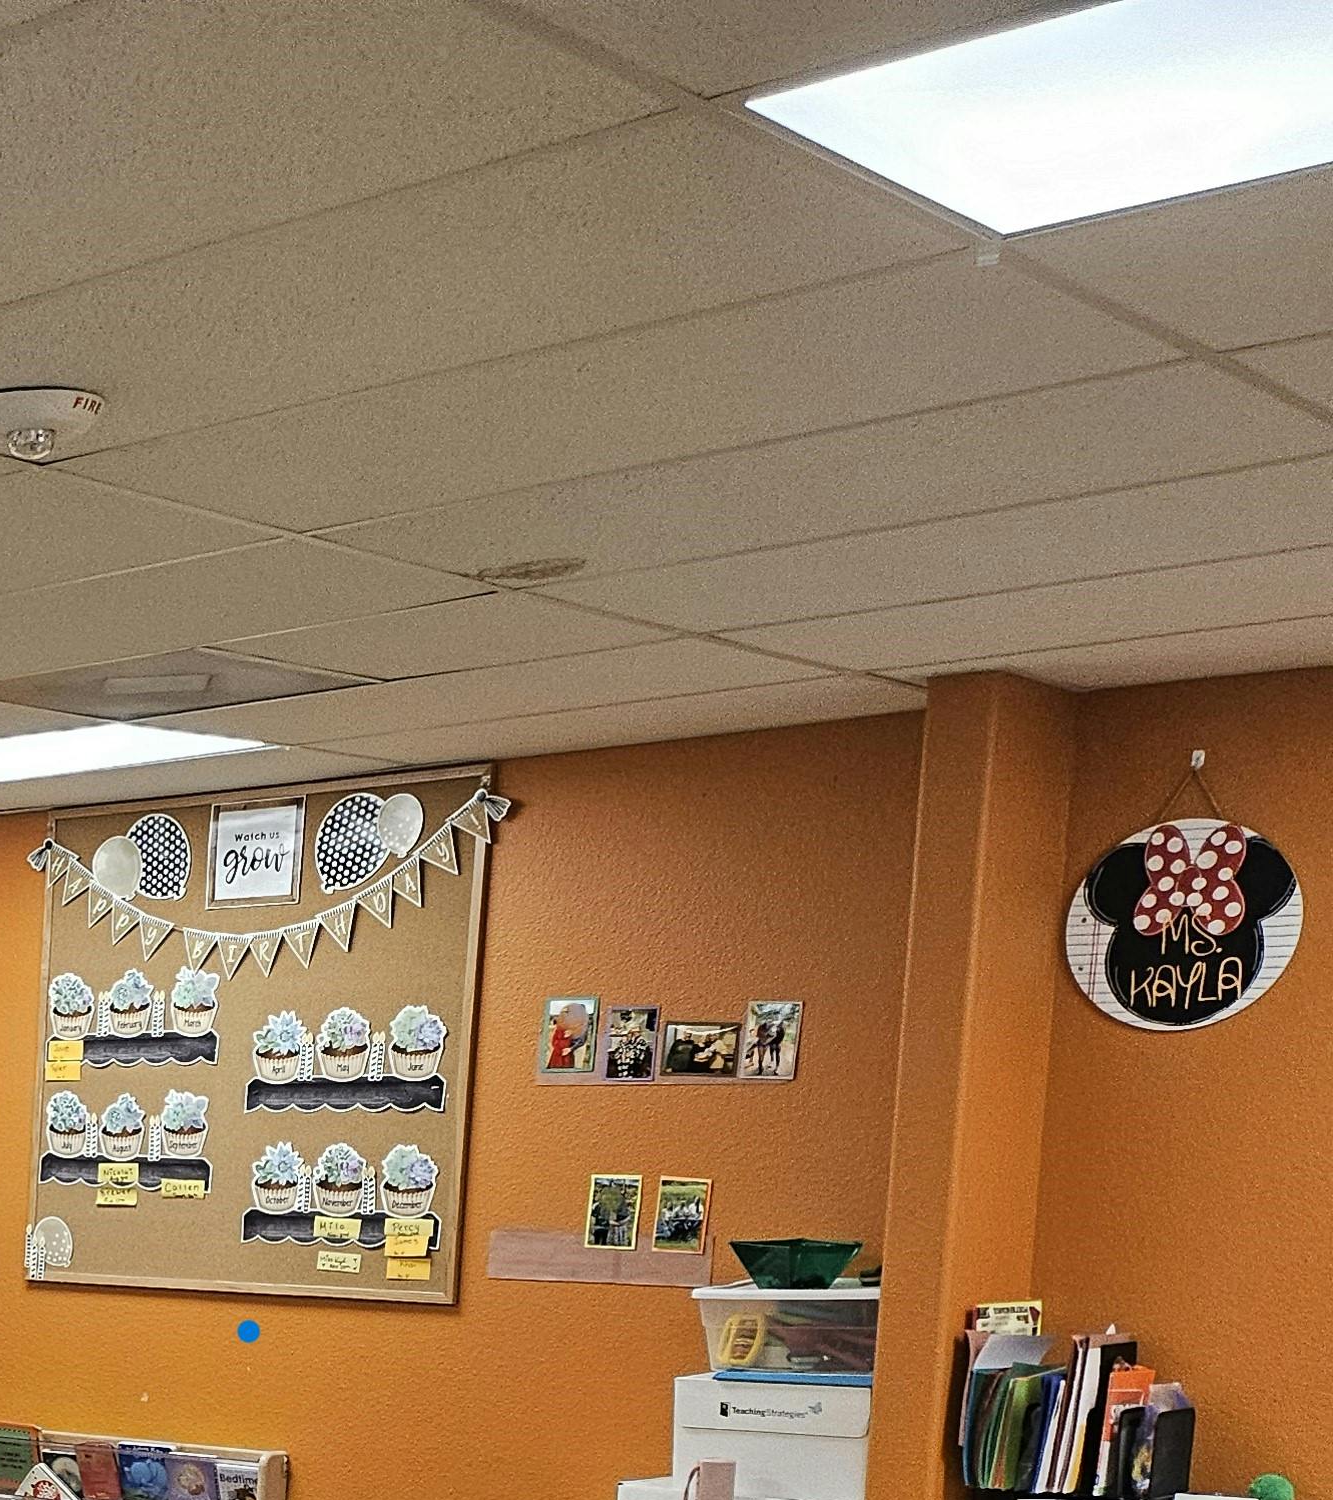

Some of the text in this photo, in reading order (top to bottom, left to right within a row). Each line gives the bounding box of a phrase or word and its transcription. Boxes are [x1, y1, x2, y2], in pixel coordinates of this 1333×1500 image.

[235, 832, 266, 842] Watch
[224, 843, 290, 884] grow
[1130, 957, 1243, 1009] KAYLA
[271, 1065, 286, 1076] April
[336, 1063, 350, 1075] May
[61, 1141, 73, 1152] July
[319, 1221, 345, 1231] Milo
[392, 1223, 420, 1234] Percy
